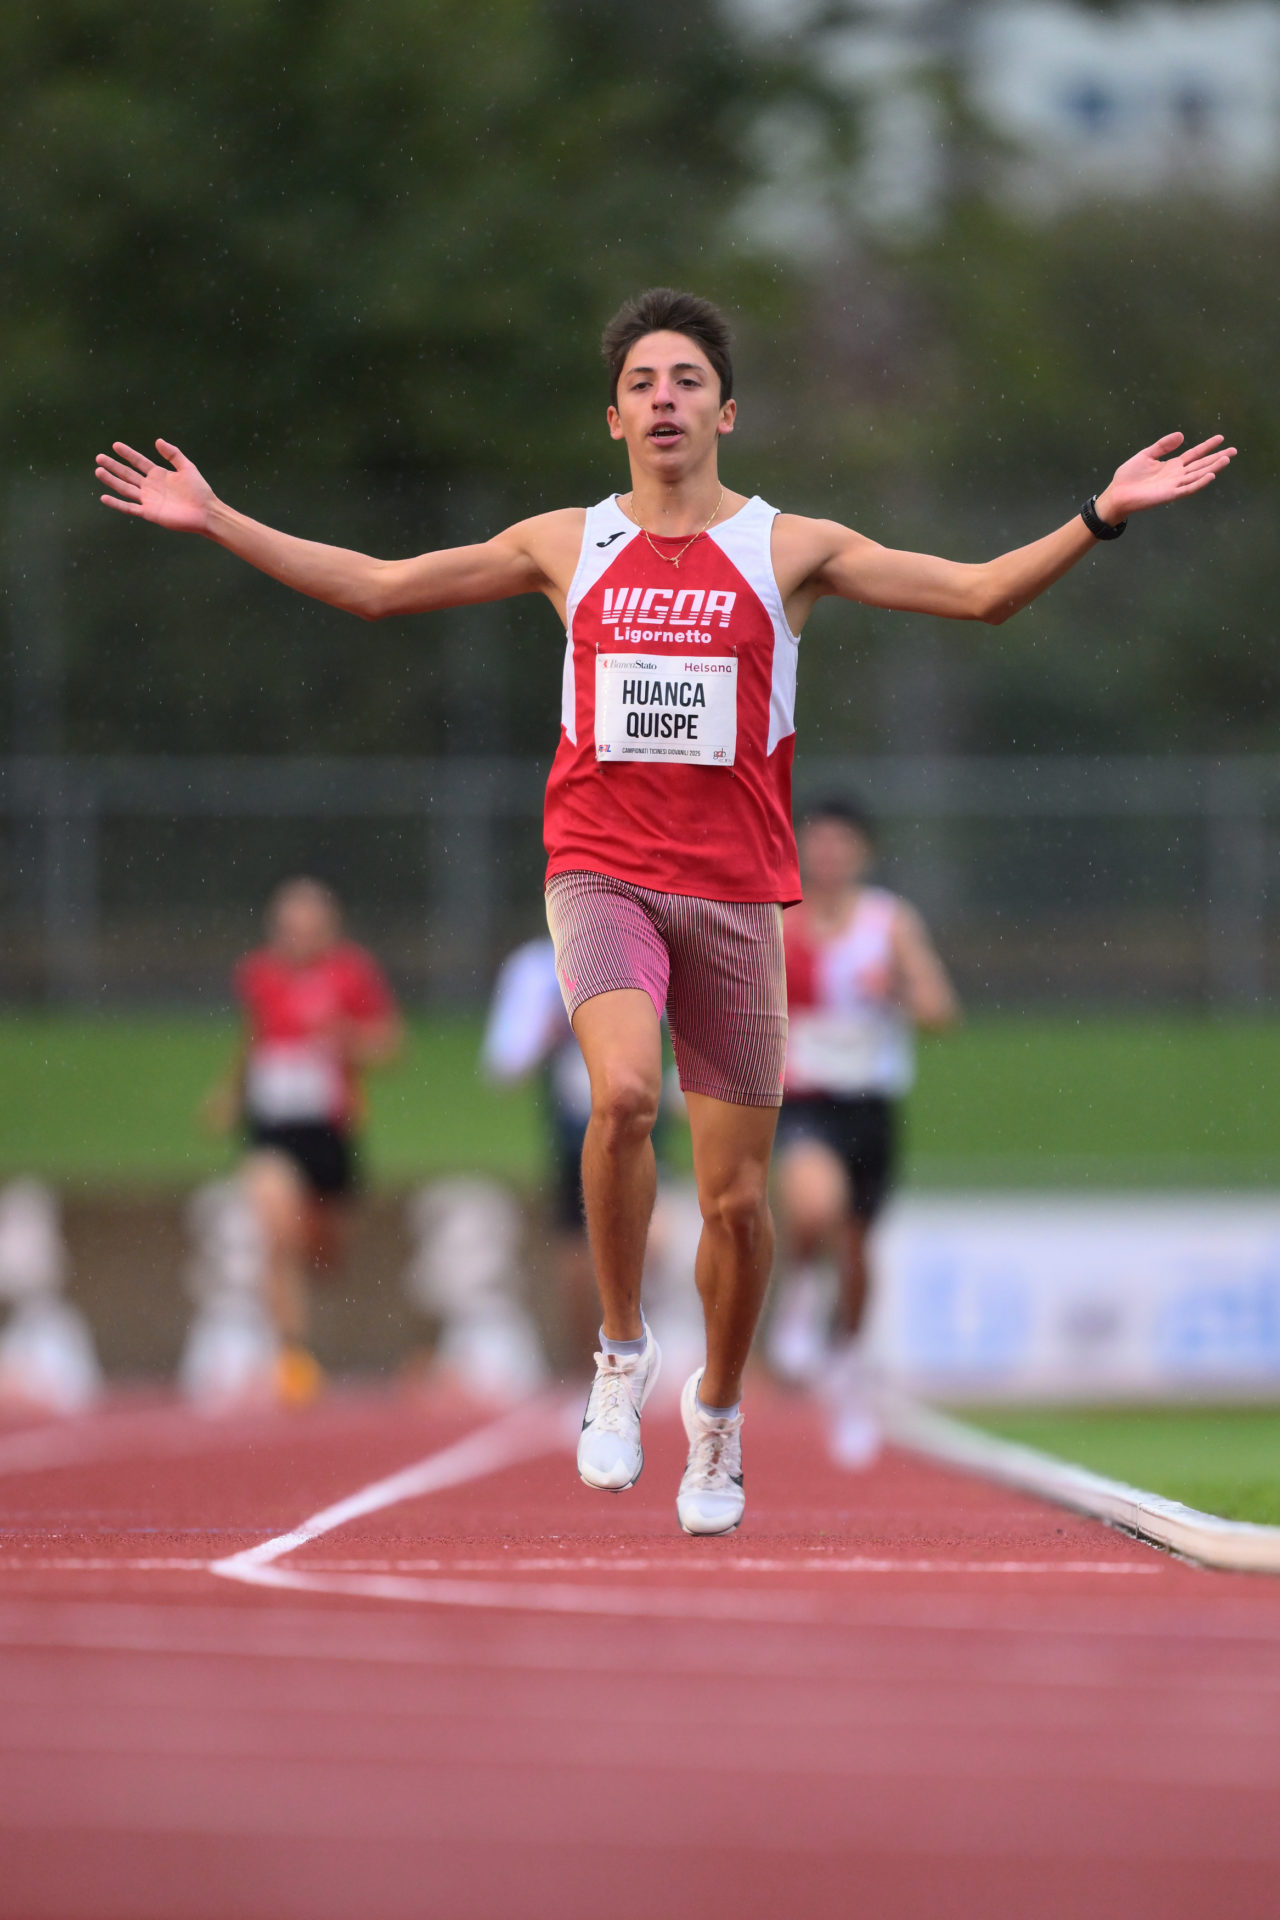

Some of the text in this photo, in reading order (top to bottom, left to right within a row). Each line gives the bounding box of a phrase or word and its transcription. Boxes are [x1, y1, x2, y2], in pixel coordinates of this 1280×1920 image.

[602, 587, 736, 628] VIGOR
[614, 627, 712, 643] Ligornetto
[684, 662, 732, 673] Helsana
[622, 680, 706, 707] HUANCA
[627, 712, 699, 739] QUISPE
